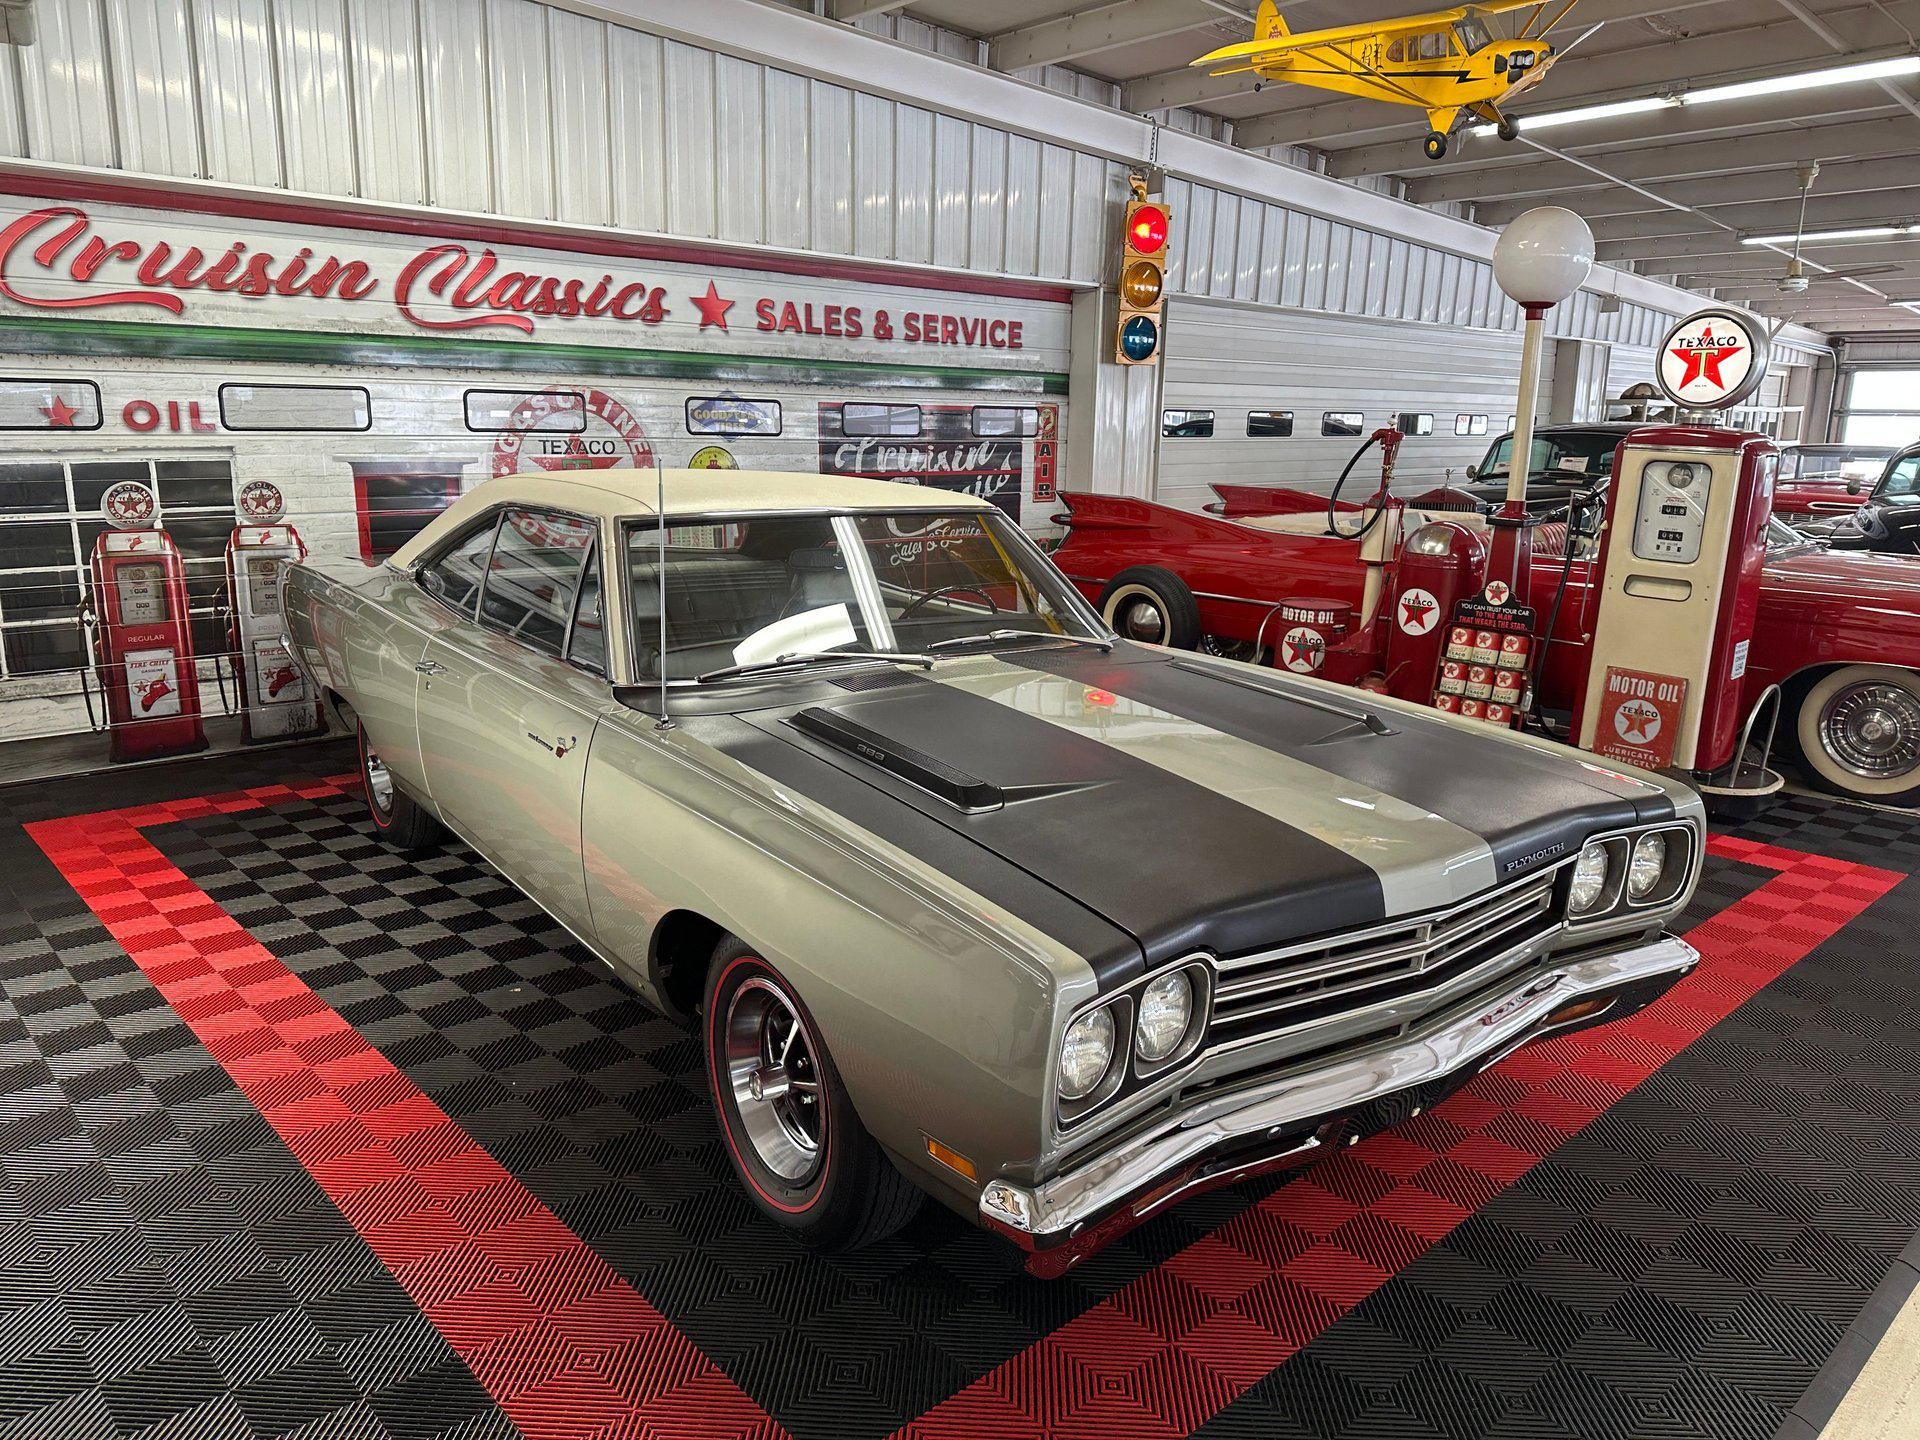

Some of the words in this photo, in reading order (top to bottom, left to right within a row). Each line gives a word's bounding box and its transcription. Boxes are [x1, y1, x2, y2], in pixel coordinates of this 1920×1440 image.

[0, 207, 378, 314] Cruisin
[395, 244, 671, 334] Classics
[755, 298, 863, 337] SALES
[873, 309, 893, 339] &
[903, 312, 1023, 348] SERVICE
[1678, 336, 1738, 348] TEXACO
[122, 399, 216, 432] OIL
[498, 388, 650, 455] GASOLINE
[538, 439, 616, 455] TEXACO
[1038, 443, 1052, 495] AIR
[108, 485, 151, 502] GASOLINE
[1403, 597, 1433, 607] TEXACO
[1282, 606, 1315, 623] MOTOR
[1317, 611, 1335, 624] OIL
[1459, 615, 1473, 623] THAT
[1484, 611, 1495, 619] THE
[128, 634, 165, 643] REGULAR
[1287, 634, 1323, 646] TEXACO
[1609, 675, 1655, 698] MOTOR
[1658, 683, 1679, 703] OIL
[1622, 705, 1658, 718] TEXACO
[857, 743, 885, 761] 383
[1603, 745, 1661, 762] LUBRICATES
[1505, 842, 1565, 872] PLYMOUTH
